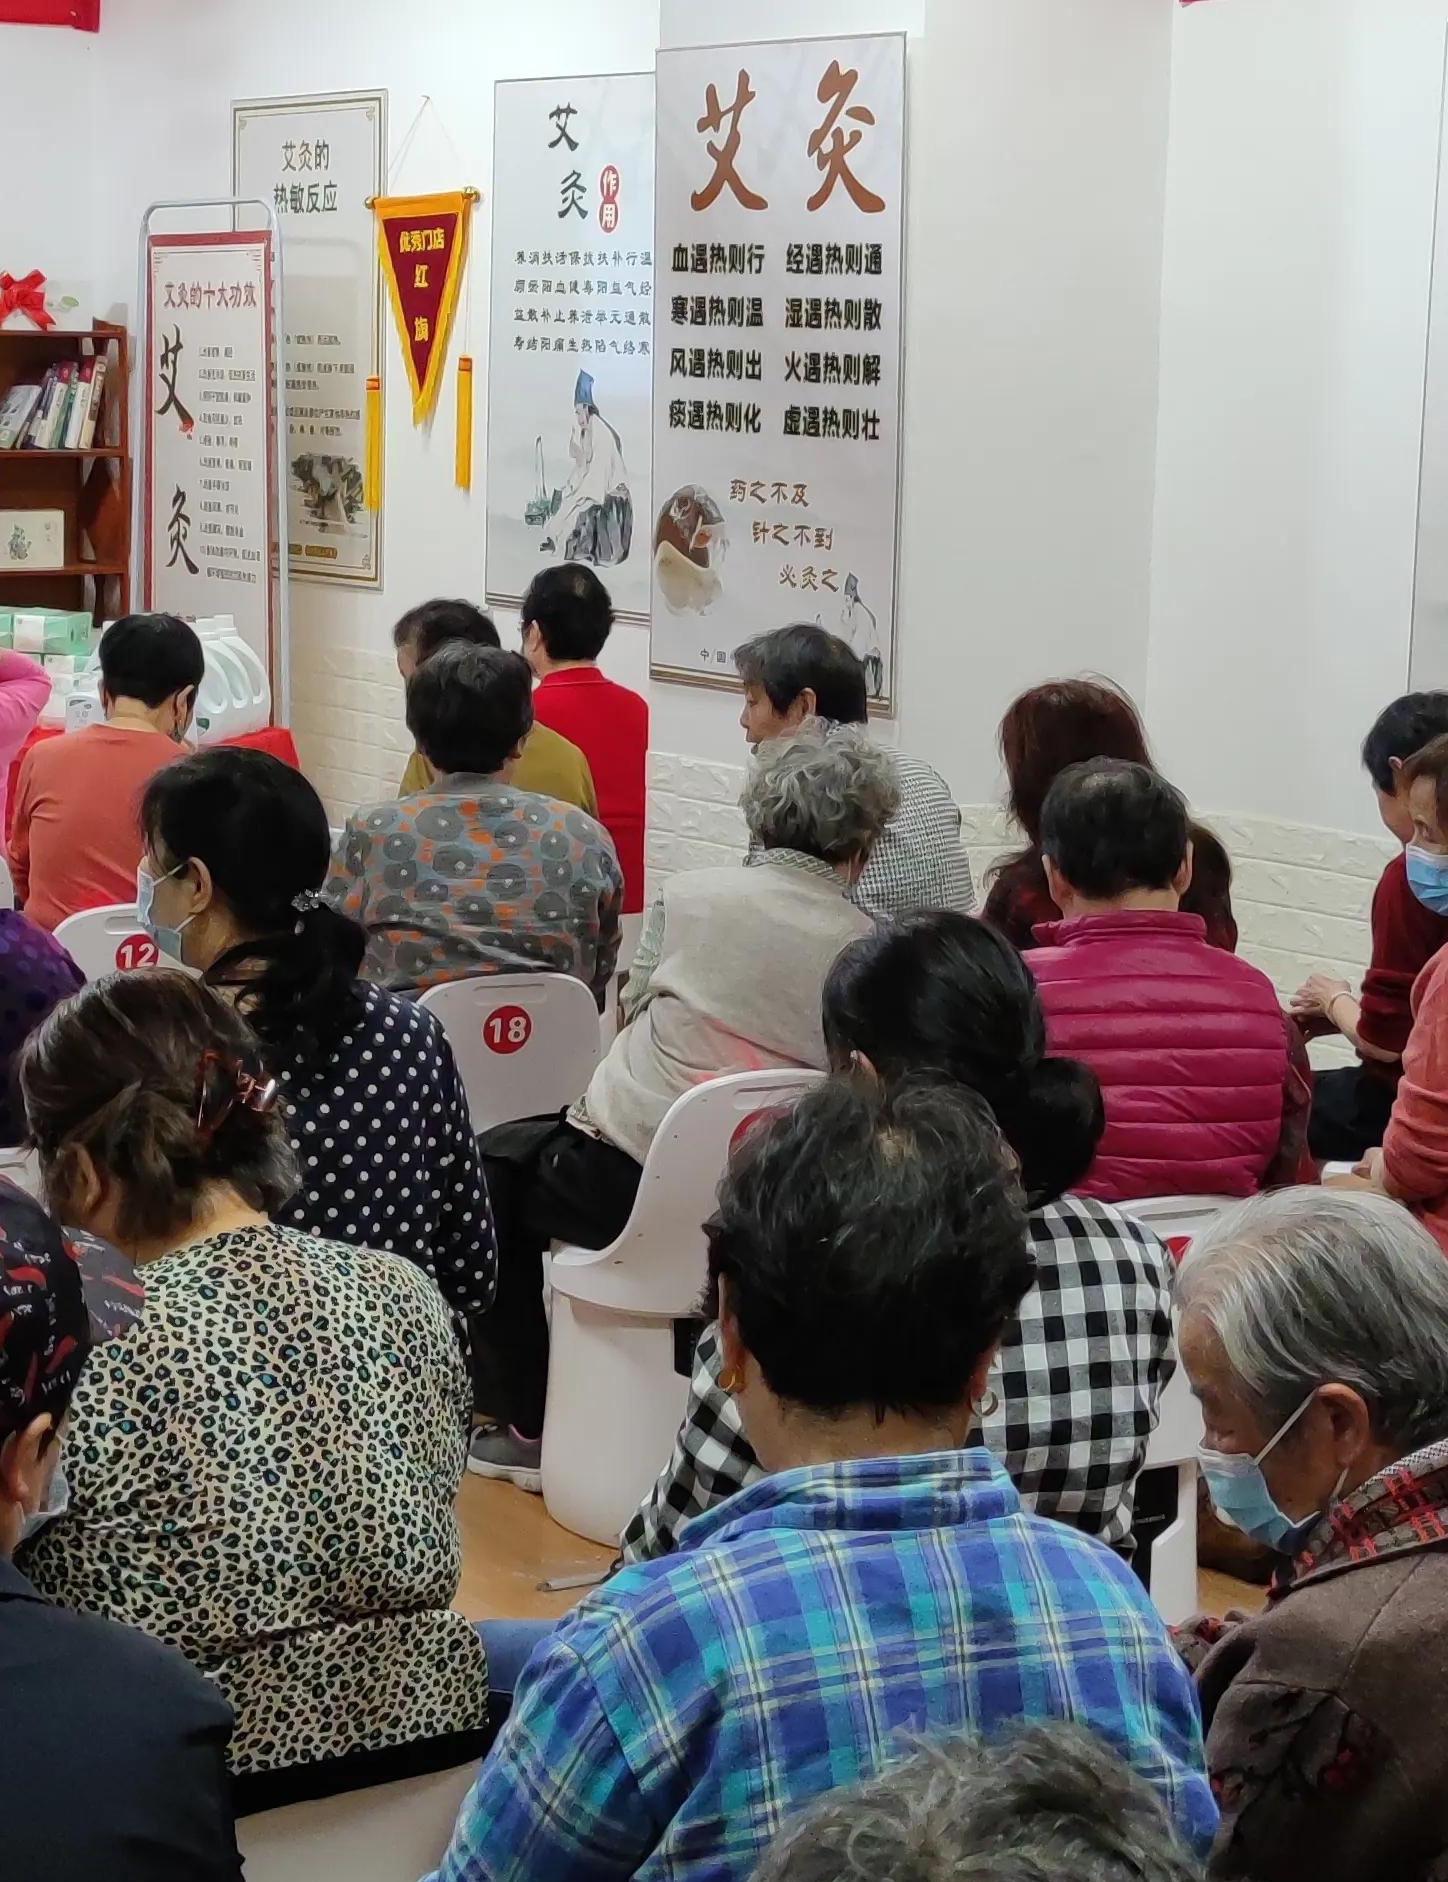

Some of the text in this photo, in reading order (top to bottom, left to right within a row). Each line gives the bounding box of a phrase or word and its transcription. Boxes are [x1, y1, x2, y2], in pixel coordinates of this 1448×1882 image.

[691, 59, 886, 213] 艾灸
[281, 139, 329, 172] 艾灸的
[273, 180, 338, 214] 热敏反应
[602, 169, 617, 229] 作用
[399, 227, 445, 253] 优秀门店
[671, 241, 766, 275] 血遇热则行
[785, 240, 883, 276] 经遇热则通
[163, 281, 258, 310] 艾灸的十大功效
[670, 294, 764, 328] 寒遇热则温
[784, 297, 882, 331] 湿遇热则散
[669, 347, 762, 382] 风遇热则出
[784, 350, 881, 386] 火遇热则解
[668, 397, 761, 434] 痰遇热则化
[782, 404, 880, 442] 虚遇热则壮
[728, 478, 809, 508] 药之不及
[752, 520, 834, 551] 针之不到
[778, 564, 840, 593] 必灸之
[120, 942, 155, 969] 12
[489, 1016, 528, 1044] 18
